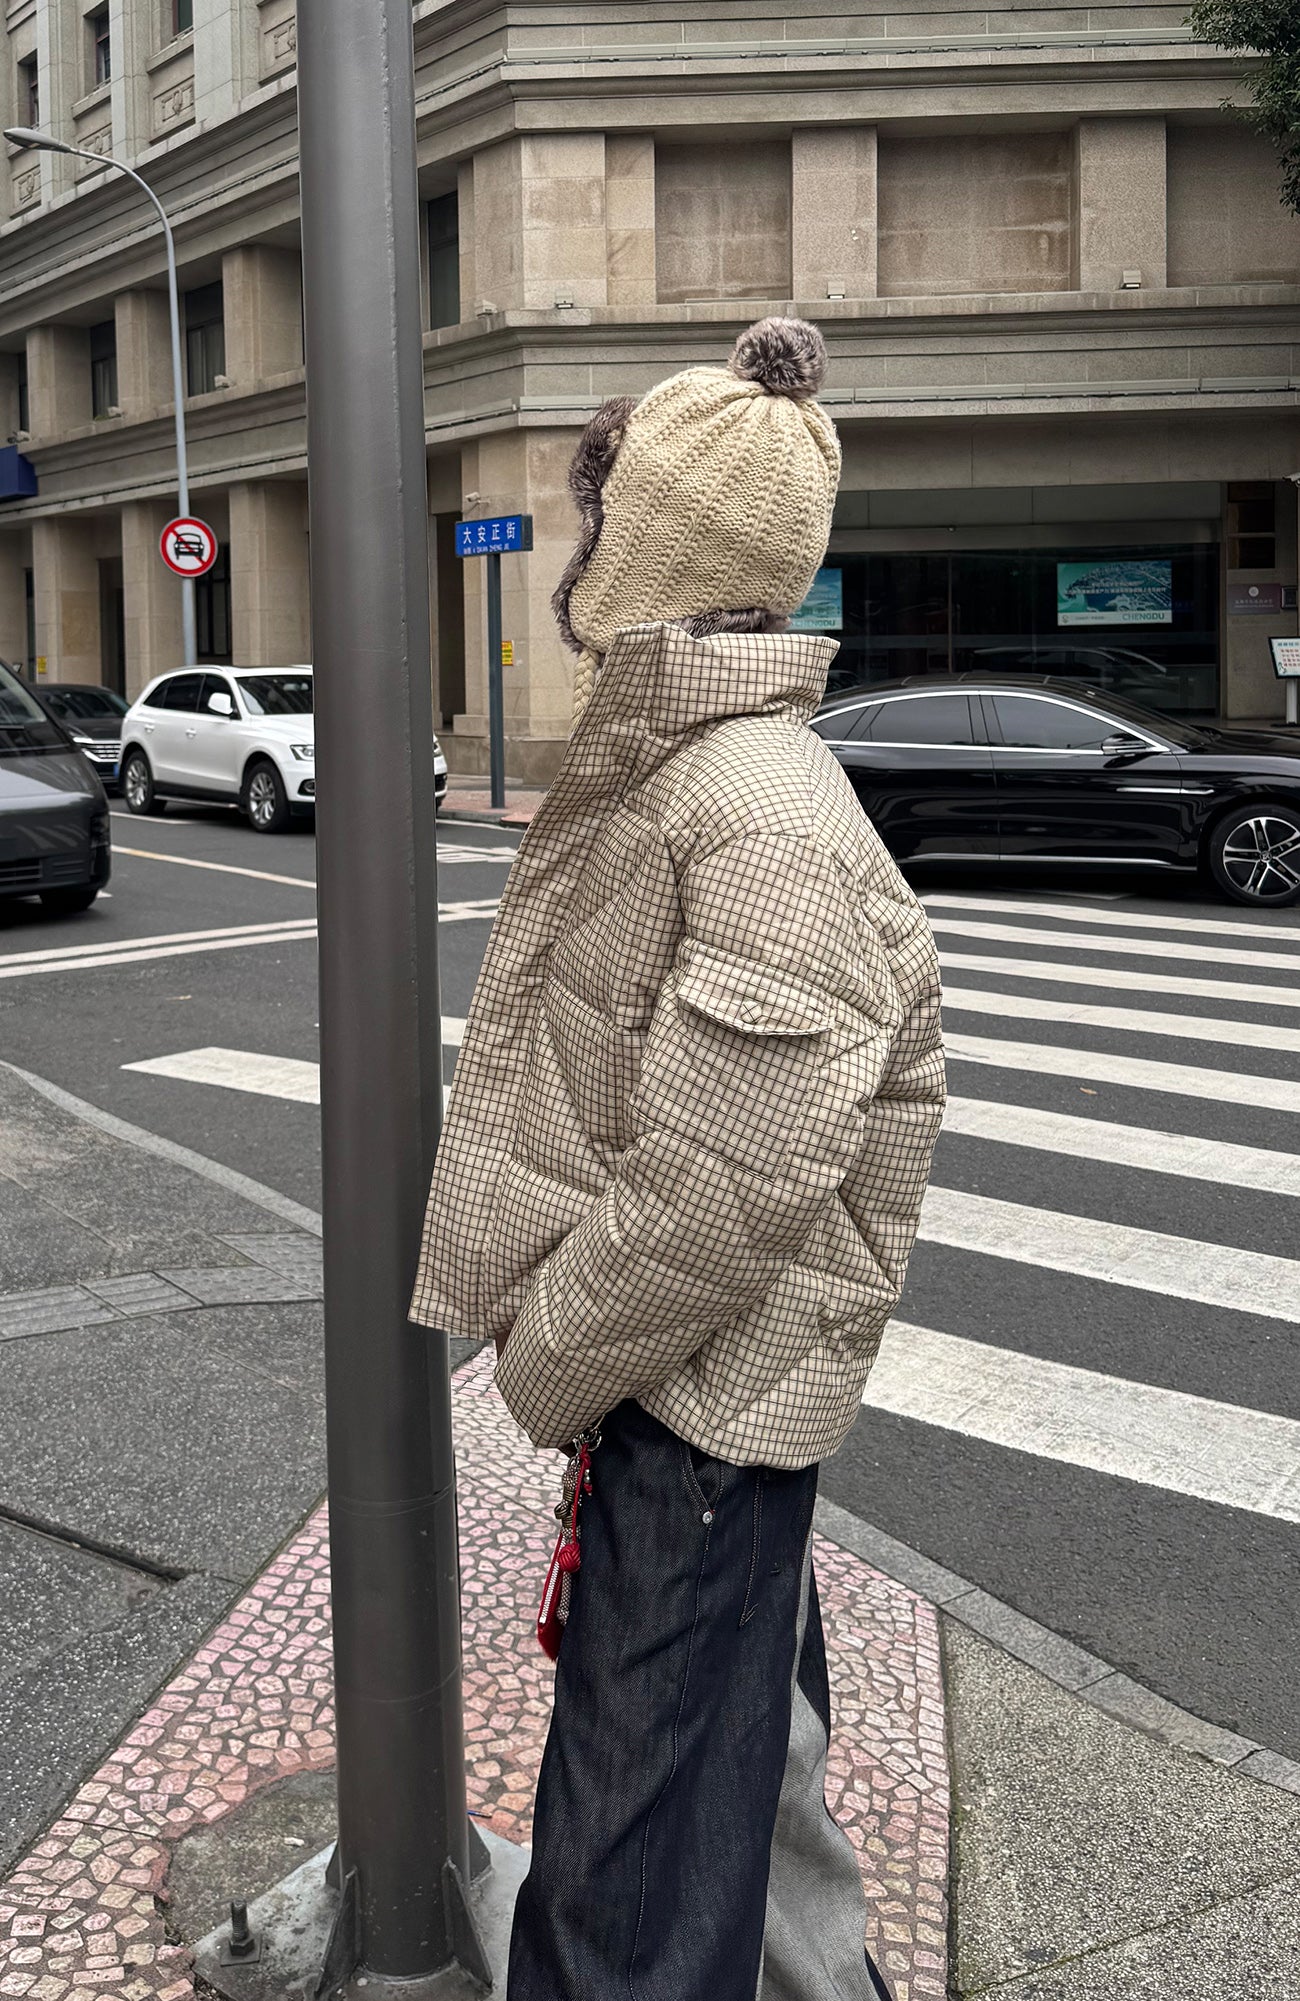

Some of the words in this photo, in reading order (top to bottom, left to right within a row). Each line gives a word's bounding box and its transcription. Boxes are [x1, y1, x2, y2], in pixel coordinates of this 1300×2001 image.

[463, 522, 516, 545] 大安正街
[1121, 612, 1165, 621] CHENGDU
